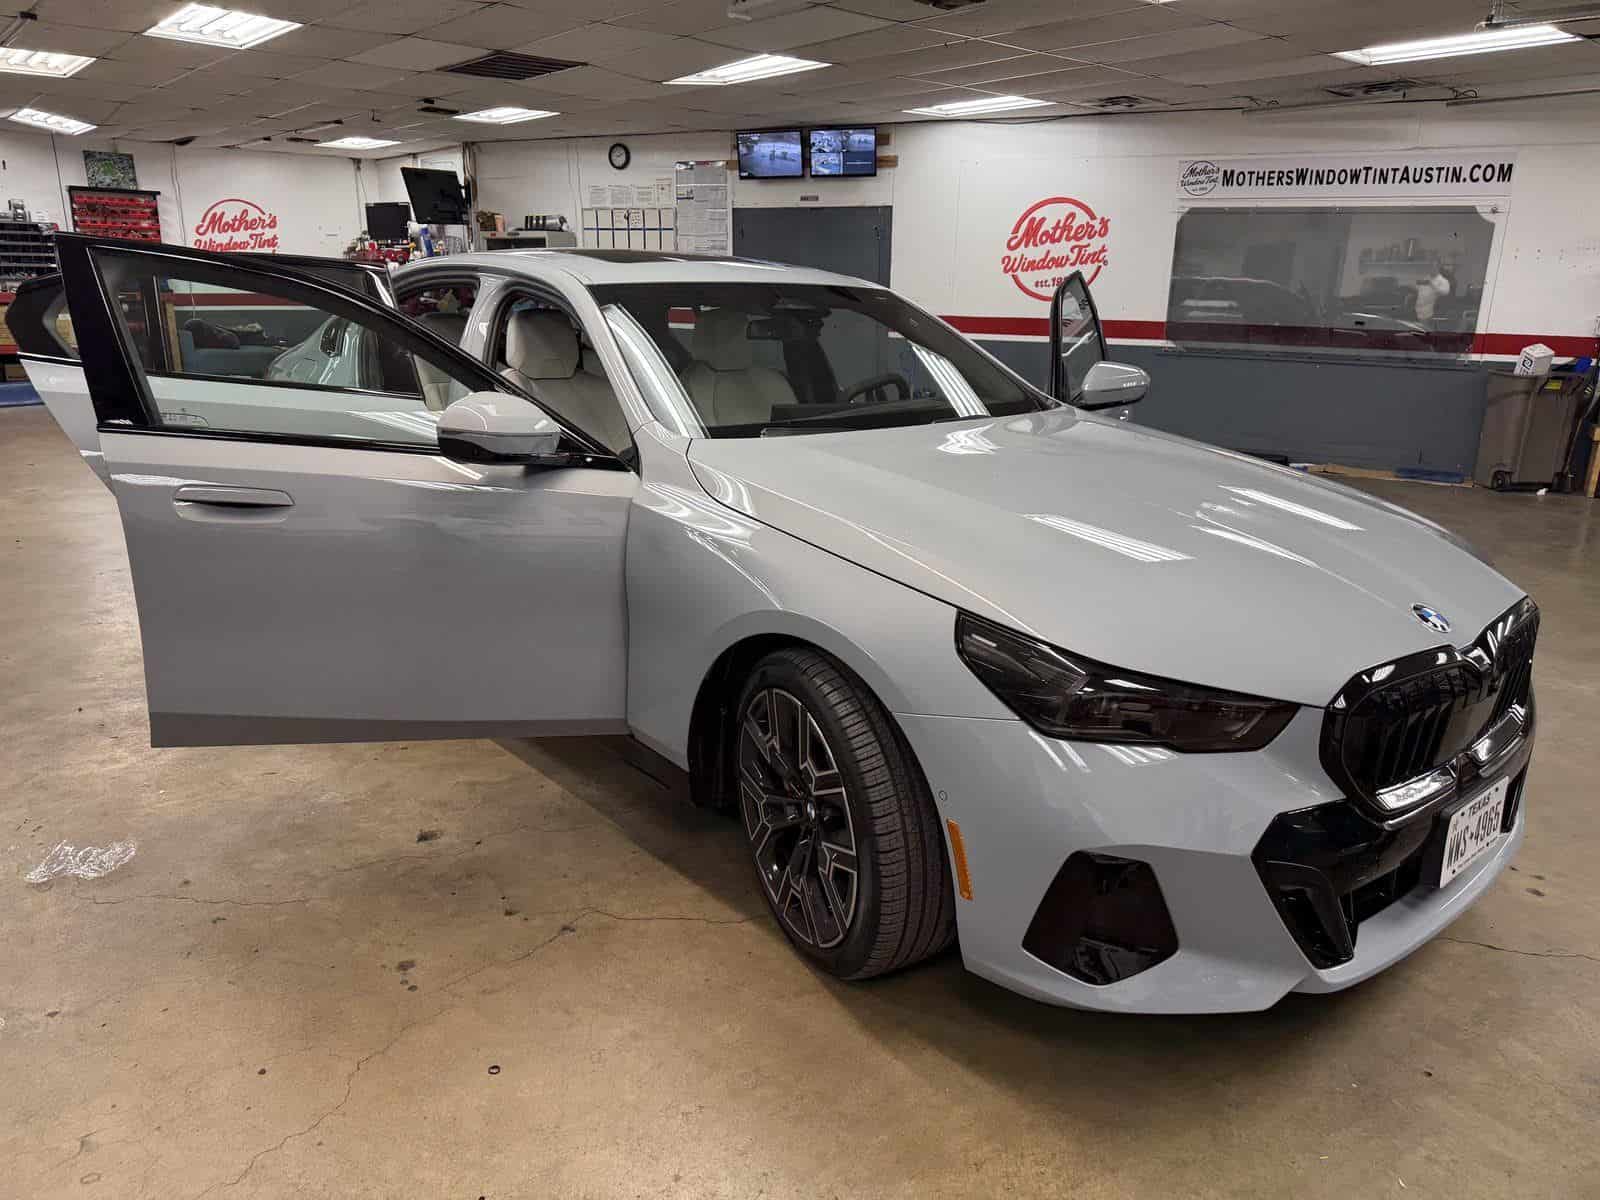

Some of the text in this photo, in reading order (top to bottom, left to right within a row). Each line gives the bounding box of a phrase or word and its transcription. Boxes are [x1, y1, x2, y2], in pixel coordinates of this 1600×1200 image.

[195, 208, 278, 236] Mother's
[1006, 211, 1111, 251] Mother's
[194, 232, 279, 253] Window Tint
[1001, 243, 1108, 274] Window Tint
[1468, 791, 1491, 816] TEXAS
